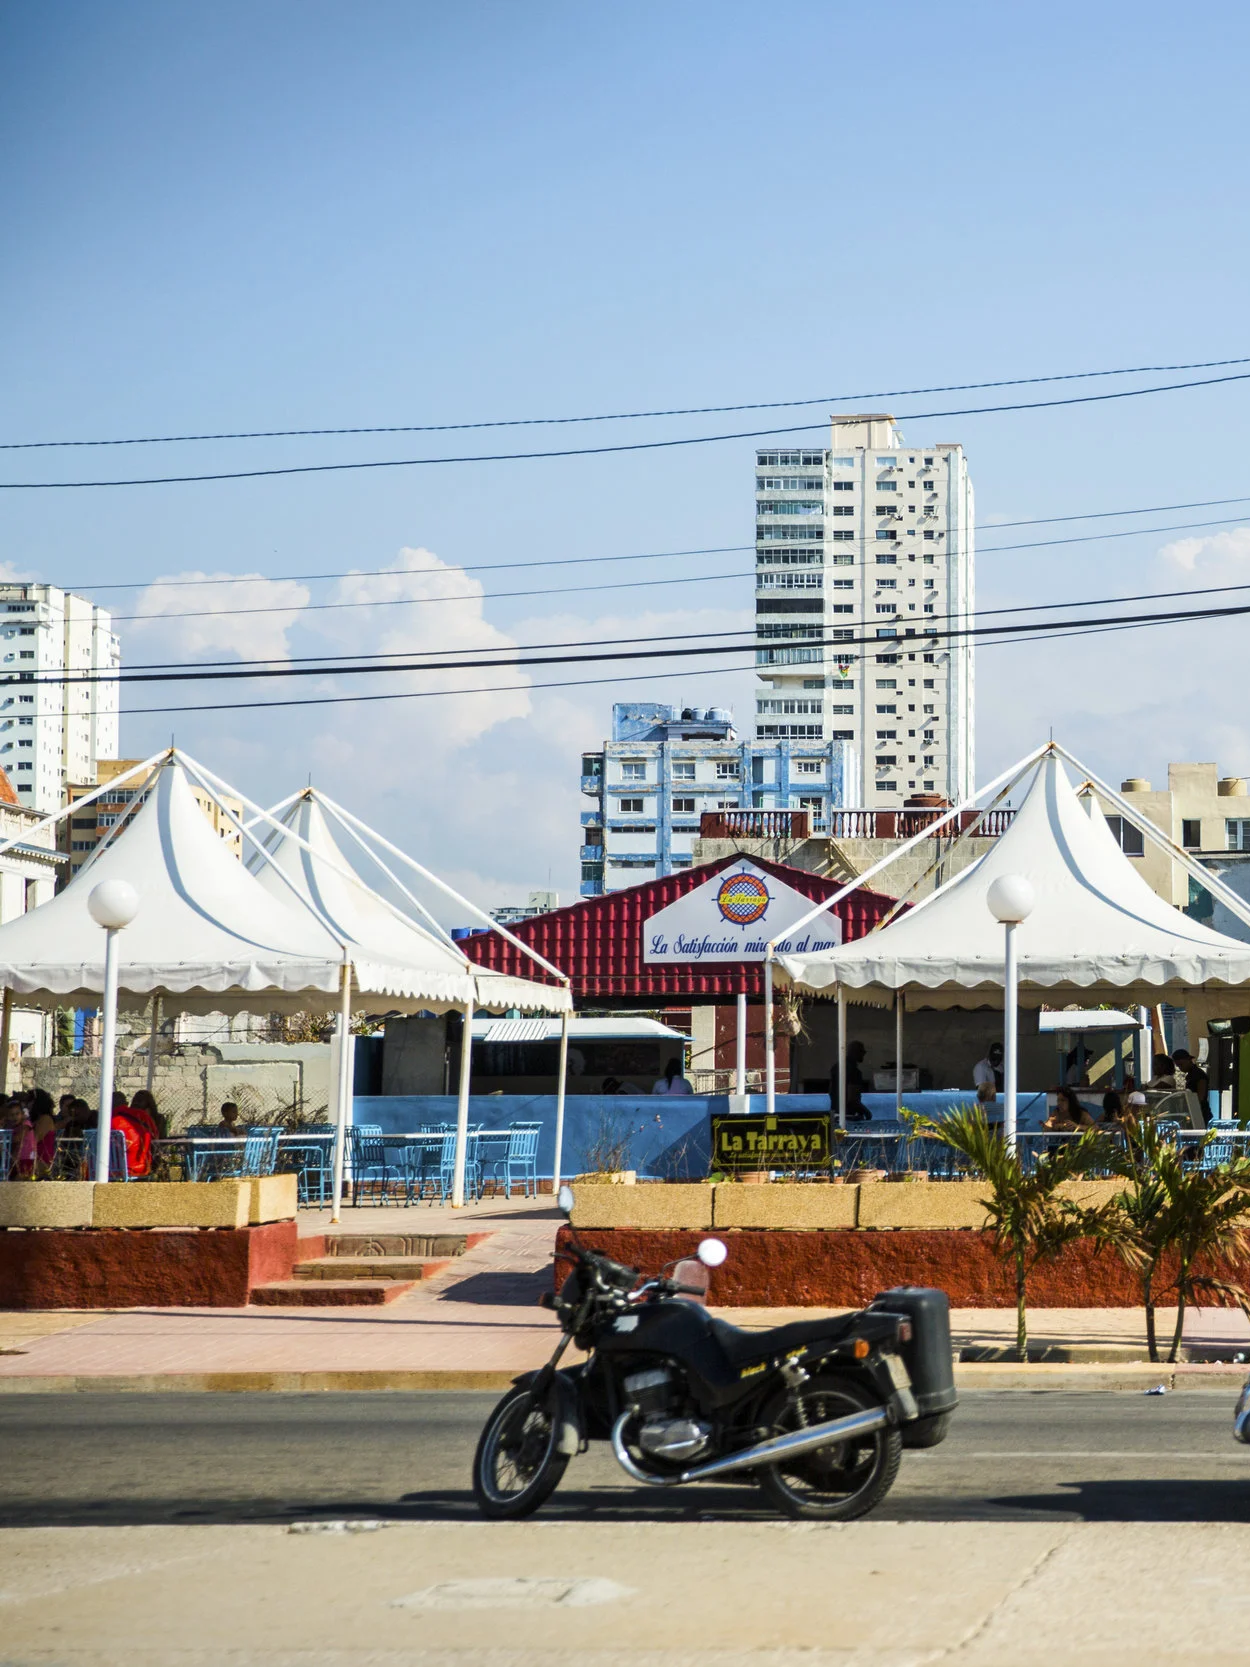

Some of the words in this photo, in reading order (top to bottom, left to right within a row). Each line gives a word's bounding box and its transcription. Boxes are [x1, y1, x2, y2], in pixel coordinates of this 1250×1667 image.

[650, 934, 668, 954] La
[674, 934, 738, 959] Satisfacción
[796, 931, 810, 952] al
[722, 1132, 742, 1151] La
[747, 1132, 821, 1153] Tarraya
